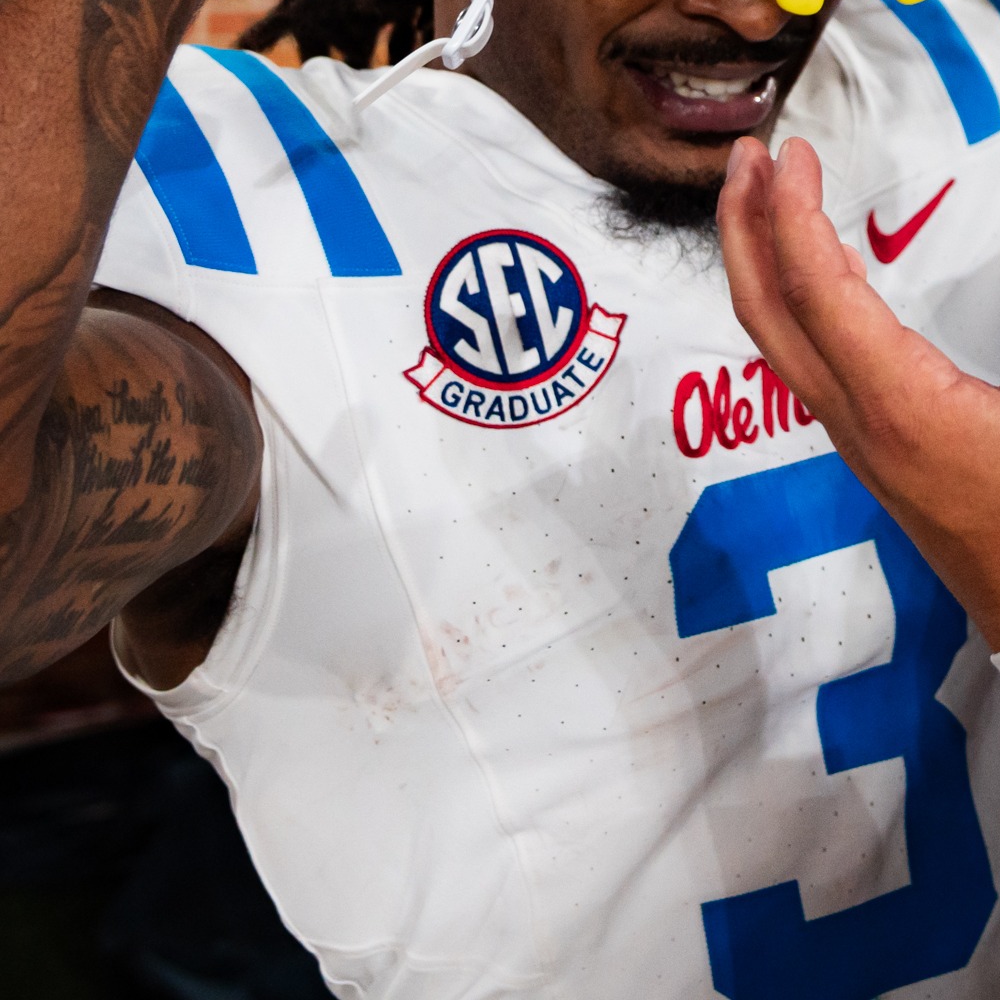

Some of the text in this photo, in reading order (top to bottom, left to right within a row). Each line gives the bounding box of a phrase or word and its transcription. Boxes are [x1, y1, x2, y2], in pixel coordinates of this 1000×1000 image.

[439, 241, 574, 376] SEC
[440, 346, 605, 423] GRADUATE
[673, 364, 760, 459] Ole
[668, 451, 999, 1000] 3
